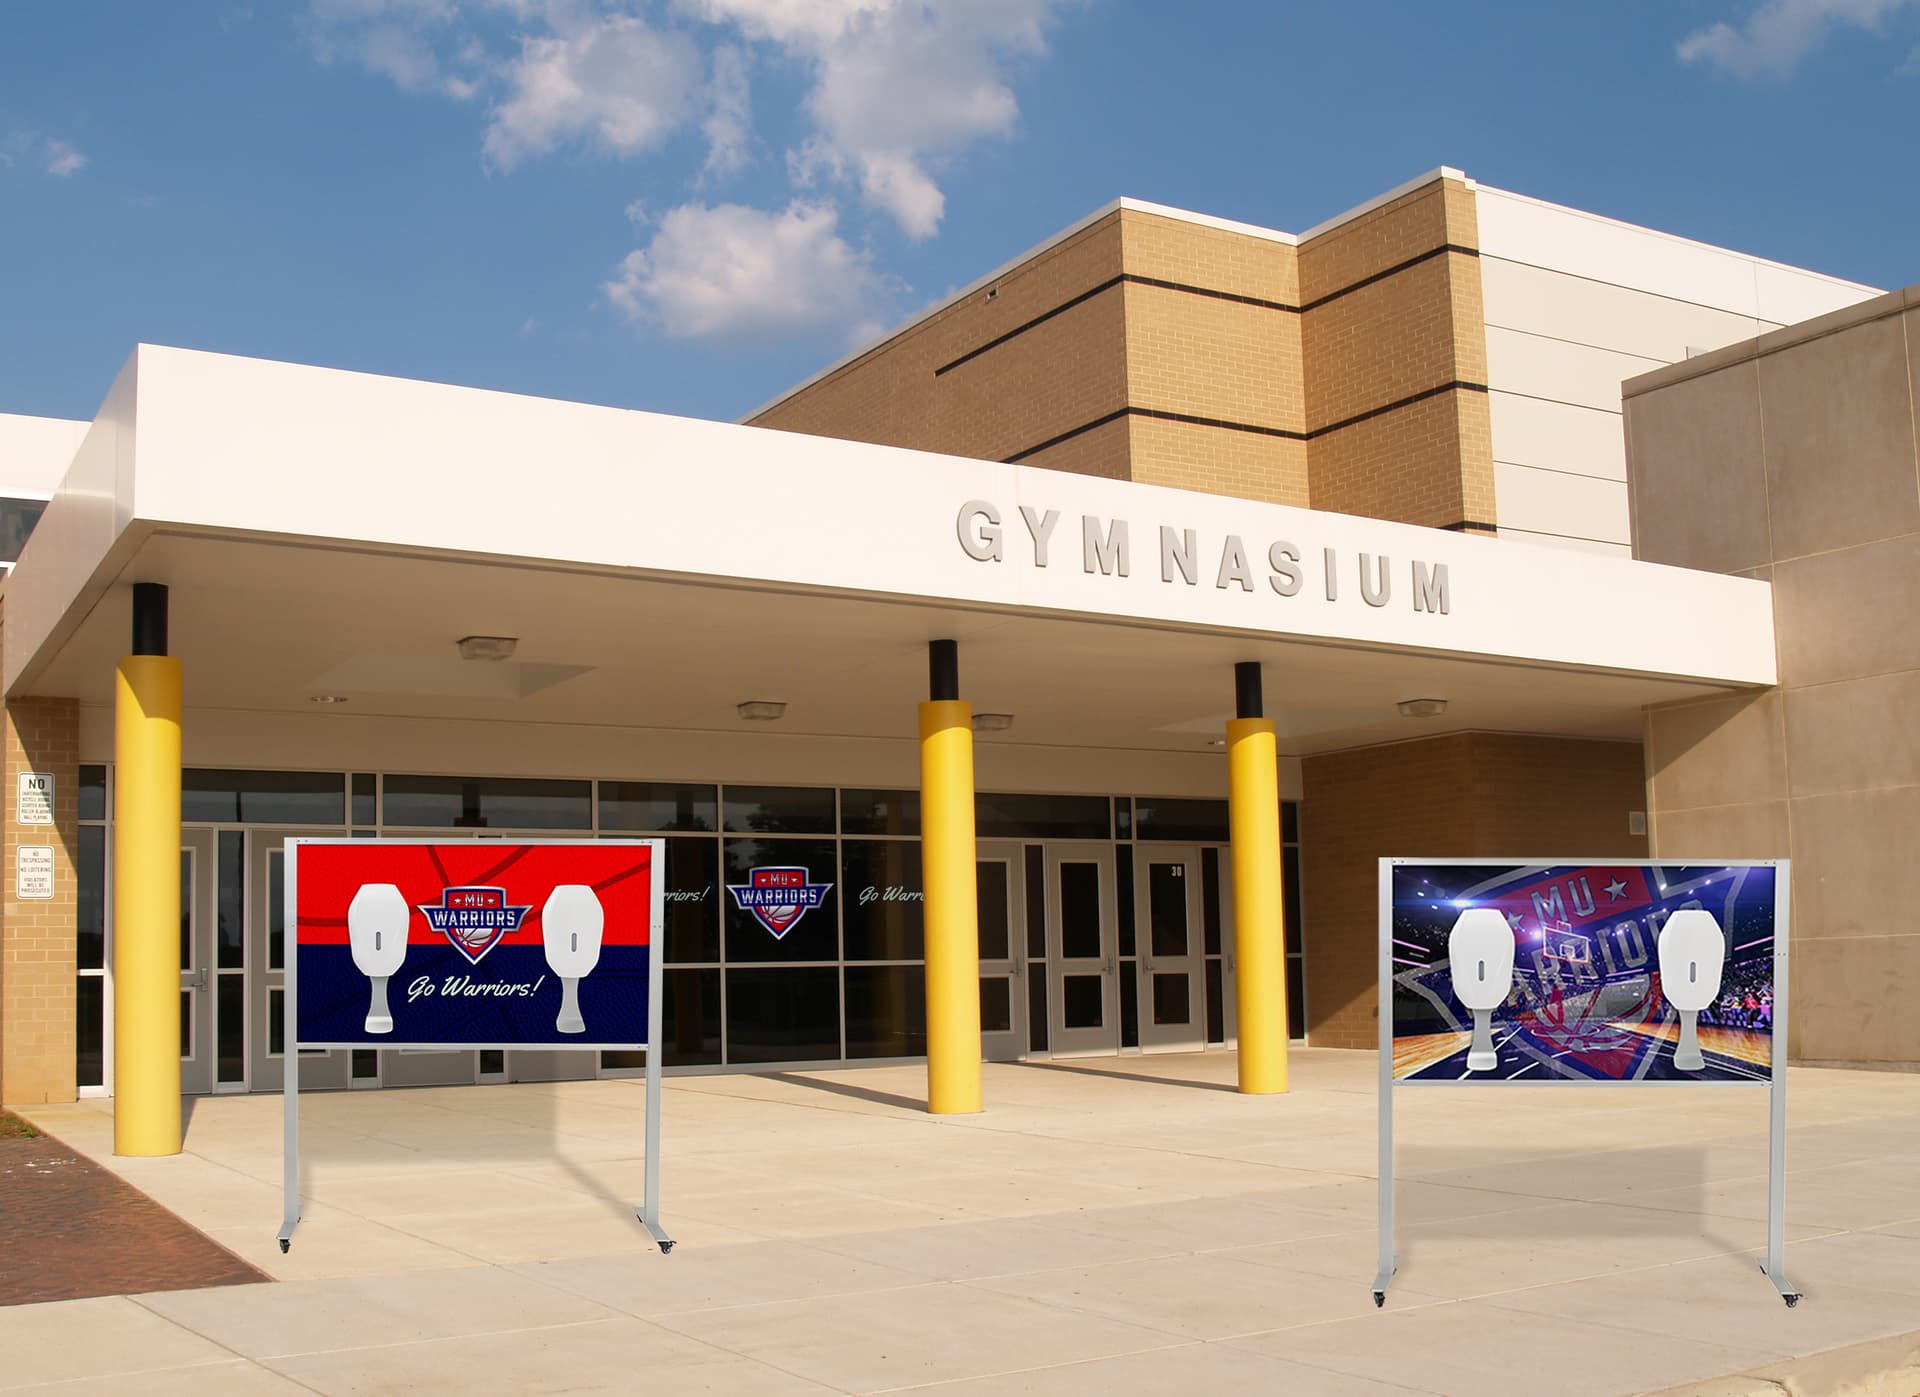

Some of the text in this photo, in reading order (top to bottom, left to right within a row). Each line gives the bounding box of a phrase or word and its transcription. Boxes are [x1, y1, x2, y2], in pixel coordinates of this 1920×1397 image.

[956, 499, 1451, 615] GYMNASIUM
[28, 779, 45, 790] NO
[1171, 865, 1182, 877] 30
[770, 873, 788, 885] MU
[464, 893, 484, 907] MU
[741, 889, 817, 904] WARRIORS
[859, 886, 879, 906] Go
[1531, 876, 1596, 924] MU
[433, 910, 516, 926] WARRIORS
[407, 974, 546, 1003] Go Warriors!
